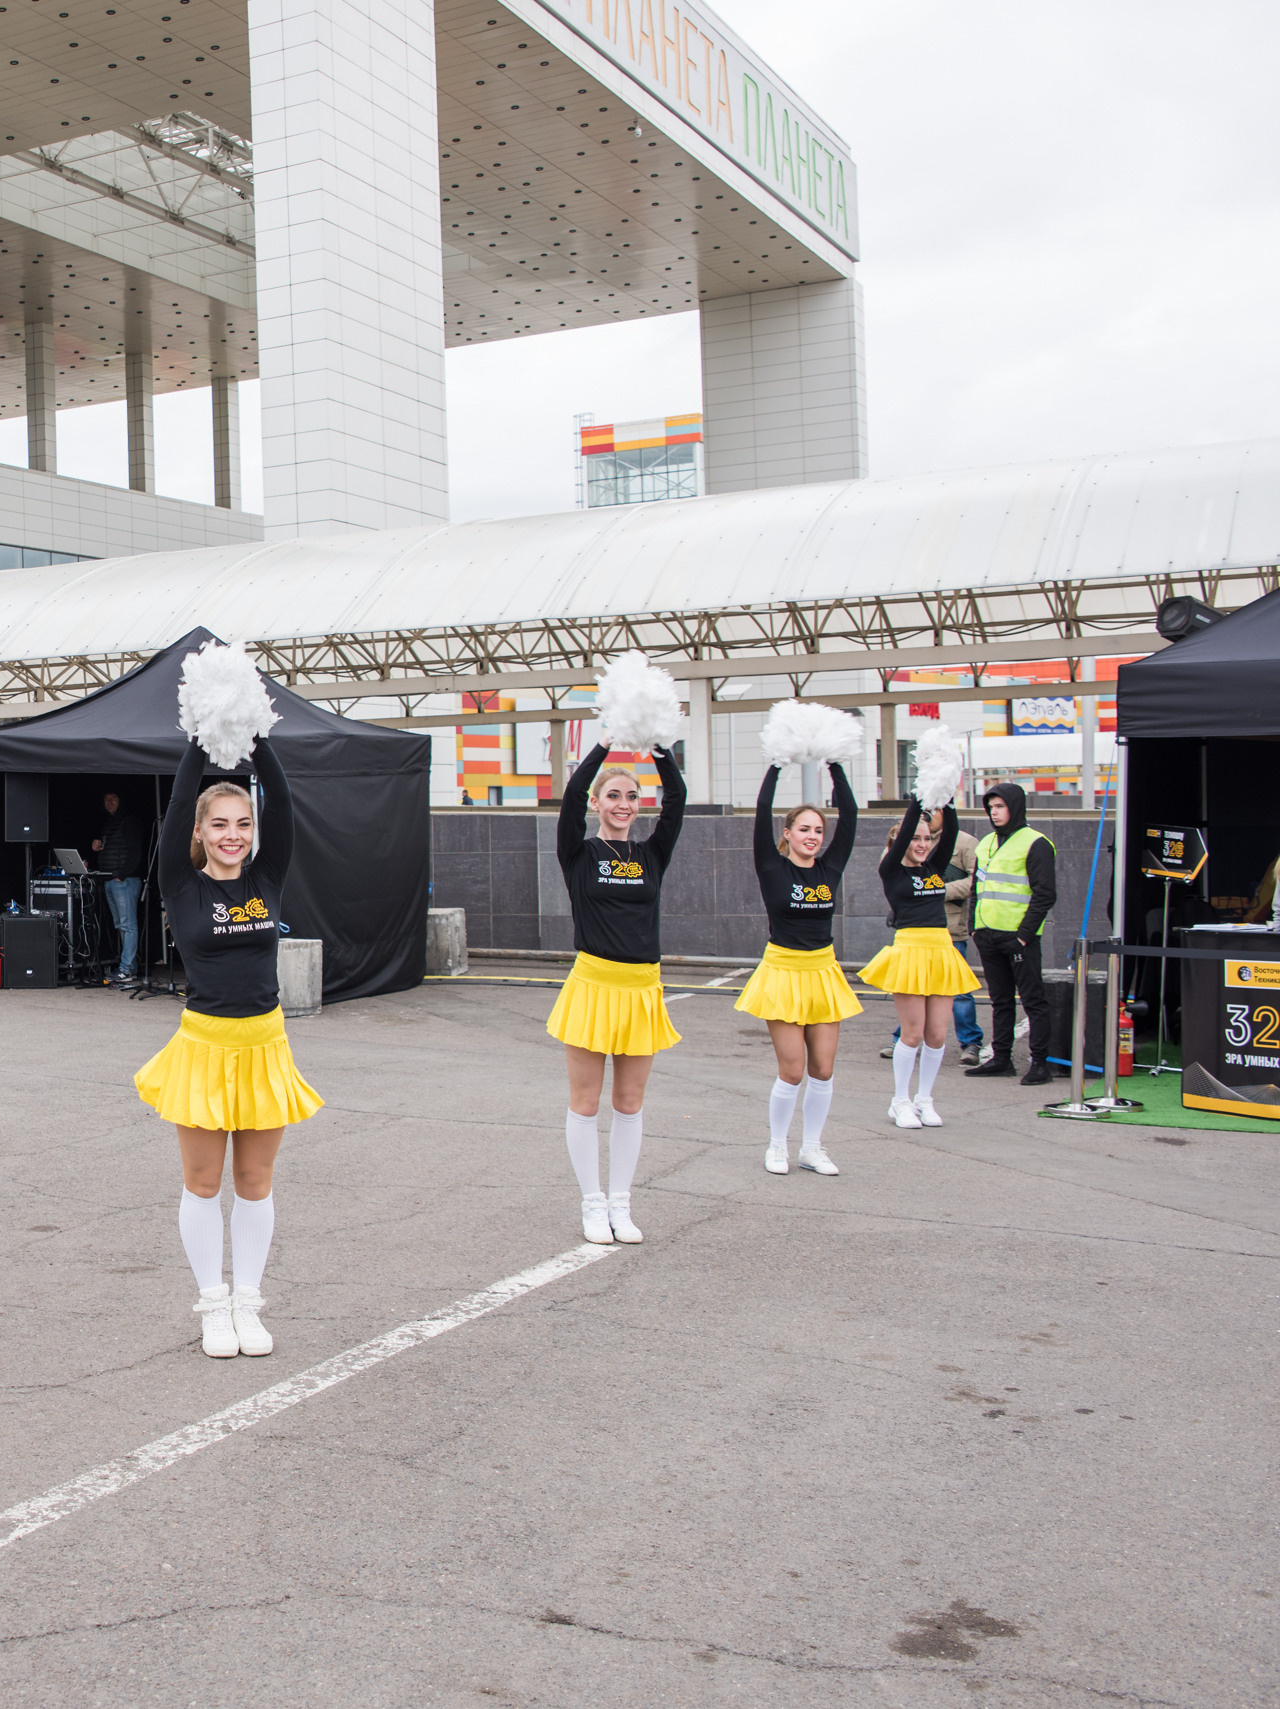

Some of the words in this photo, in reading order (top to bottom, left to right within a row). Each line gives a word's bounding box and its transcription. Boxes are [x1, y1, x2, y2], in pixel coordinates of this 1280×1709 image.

[743, 73, 848, 240] ПЛАНЕТА
[213, 926, 227, 935] ЭРА
[228, 923, 254, 934] УМНЫХ
[254, 920, 275, 930] МАШИН
[1225, 1053, 1243, 1065] ЭРА
[1244, 1055, 1279, 1068] УМНЫХ
